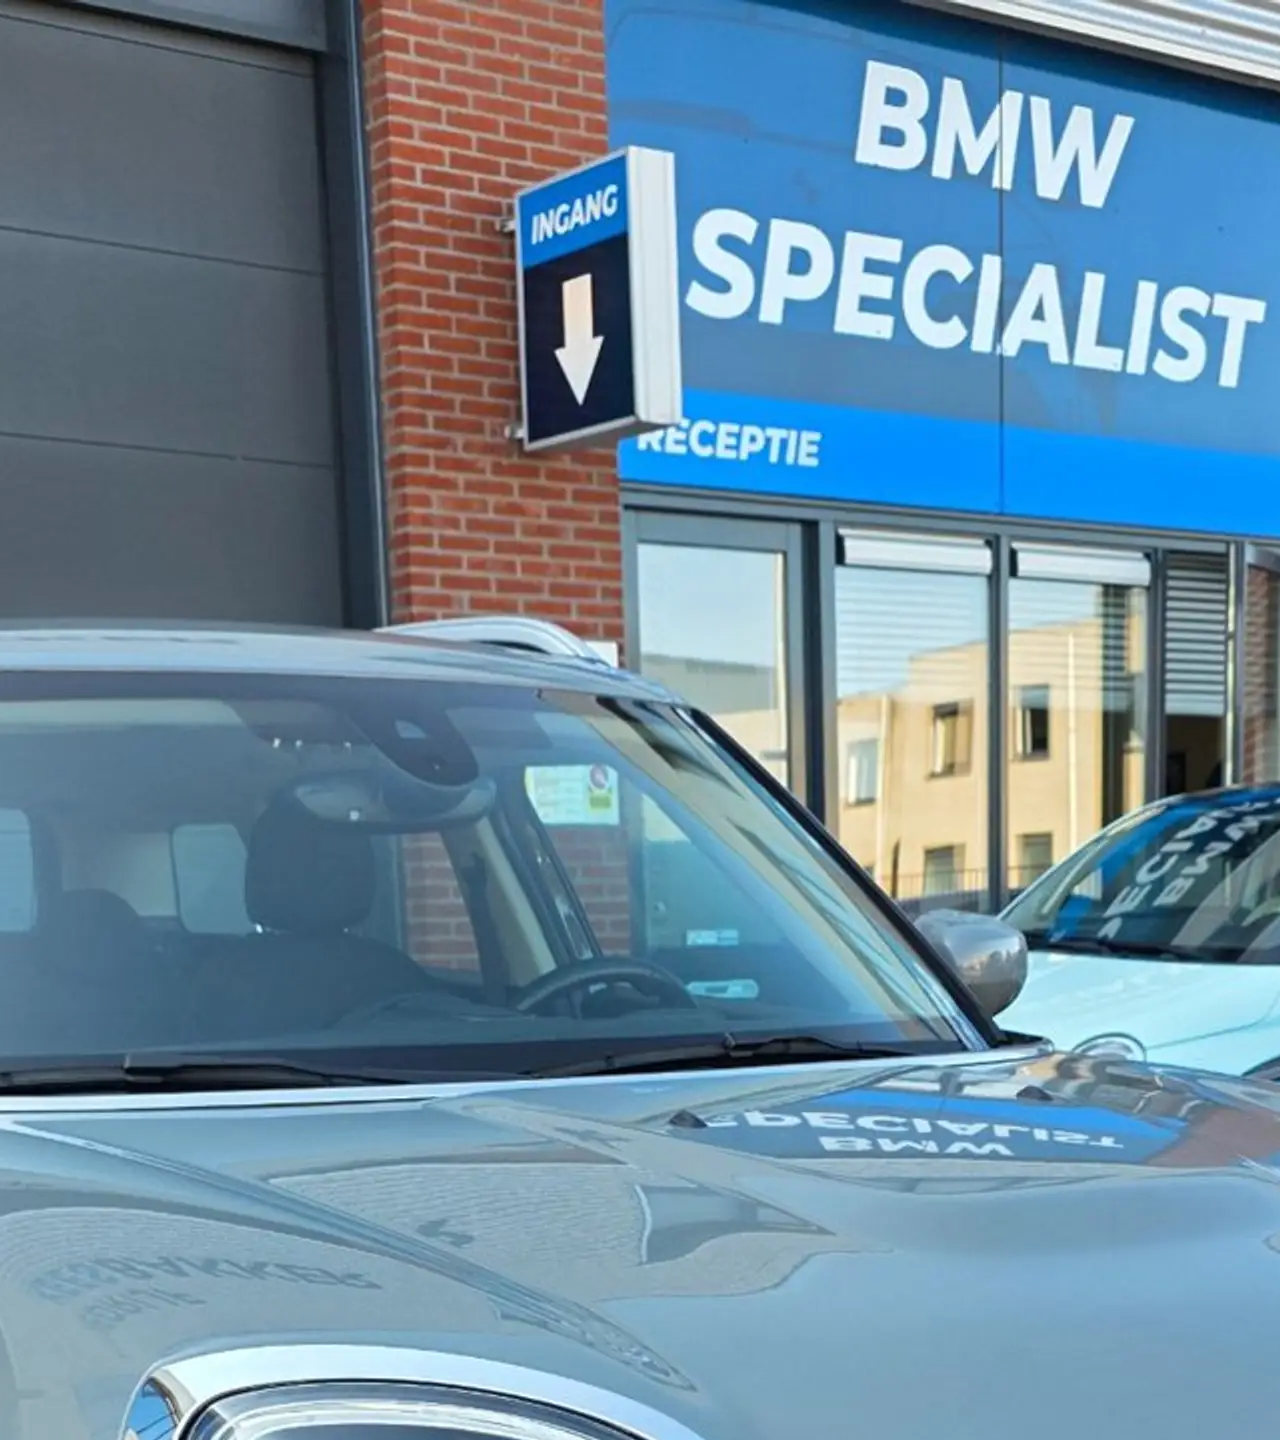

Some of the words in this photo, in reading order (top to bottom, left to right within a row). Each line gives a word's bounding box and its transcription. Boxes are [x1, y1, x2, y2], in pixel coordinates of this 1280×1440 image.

[855, 60, 1135, 208] BMW
[531, 184, 618, 245] INGANG
[685, 208, 1266, 389] SPECIALIST
